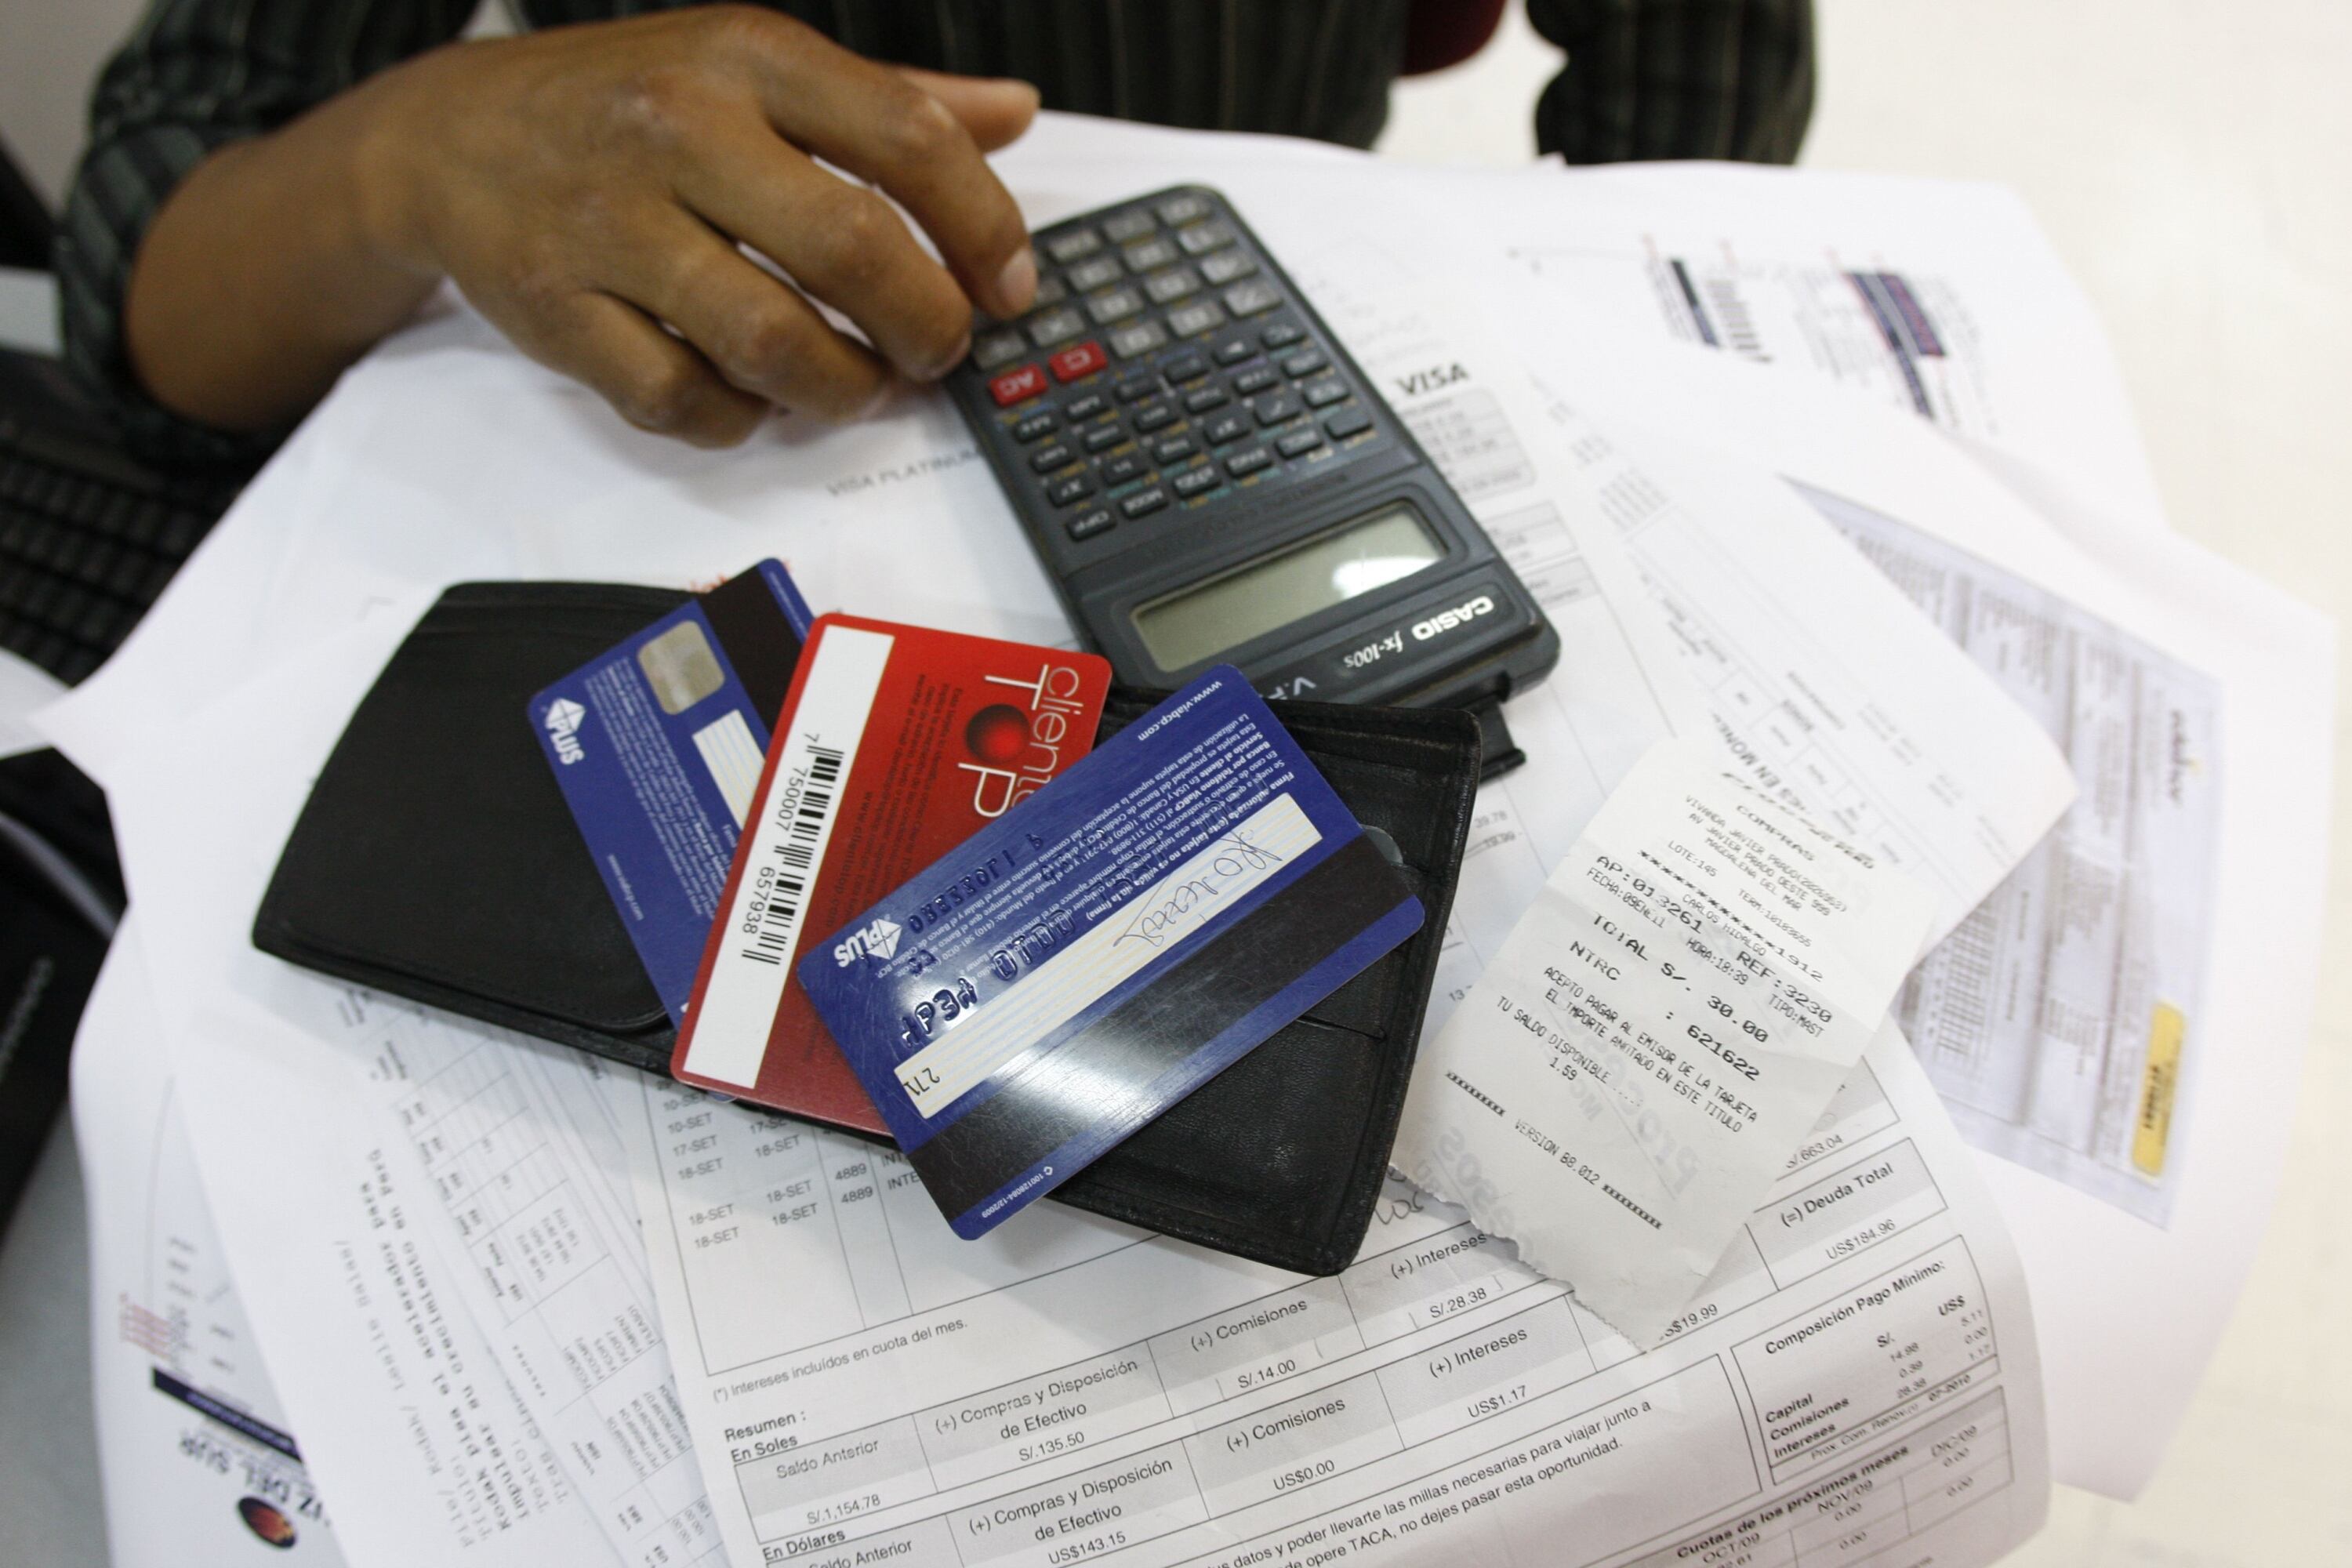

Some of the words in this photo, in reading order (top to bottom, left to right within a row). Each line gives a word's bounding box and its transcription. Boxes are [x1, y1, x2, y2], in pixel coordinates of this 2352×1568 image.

[998, 371, 1034, 397] AC
[1393, 363, 1470, 397] VISA
[1411, 596, 1494, 640] CASIO
[1344, 630, 1403, 667] fx-100s
[1137, 681, 1222, 741] www.viabcp.com
[1238, 722, 1256, 735] Esta
[550, 719, 584, 765] PLUS
[804, 732, 819, 743] 7
[1216, 732, 1240, 751] tarjeta
[1232, 731, 1263, 754] Servicio
[1245, 740, 1270, 759] Banca
[1171, 753, 1208, 785] propiedad
[1199, 757, 1225, 778] cliente
[1200, 767, 1234, 791] Teléfono
[1232, 755, 1247, 769] por
[1269, 771, 1294, 789] Firma
[775, 768, 808, 831] 750007
[1136, 789, 1160, 808] Banco
[1159, 780, 1171, 793] del
[1171, 782, 1190, 797] USA
[1174, 789, 1202, 811] ViaBCP
[1144, 812, 1167, 831] (511)
[1706, 827, 1741, 852] JAVIER
[1734, 804, 1817, 862] COMPRAS
[1667, 840, 1717, 877] LOTE:145
[1729, 829, 1765, 854] JAVIER
[742, 866, 775, 935] 657938
[1595, 855, 1710, 934] AP:013261
[1735, 949, 1832, 1023] REF:3230
[1682, 893, 1719, 924] CARLOS
[1721, 923, 1766, 956] HIDALGO
[834, 920, 887, 967] PLUS
[1685, 937, 1748, 985] HORA:18:39
[1768, 993, 1824, 1035] TIPO:MAST
[1569, 940, 1621, 981] NTRC
[1686, 1024, 1759, 1081] 621622
[1707, 995, 1769, 1043] 30.00
[1497, 995, 1512, 1012] TU
[1513, 1008, 1547, 1037] SALDO
[1548, 1033, 1609, 1083] DISPONIBLE
[1543, 966, 1584, 998] ACEPTO
[1584, 993, 1618, 1022] PAGAR
[1636, 1031, 1676, 1065] EMISOR
[1715, 1085, 1757, 1121] TARJETA
[902, 1066, 940, 1096] 271
[1548, 1056, 1577, 1081] 1.59
[1563, 997, 1606, 1038] IMPORTE
[1672, 1079, 1701, 1105] ESTE
[1704, 1100, 1742, 1133] TITULO
[668, 1111, 711, 1132] 10-SET
[1514, 1121, 1559, 1156] VERSION
[673, 1134, 717, 1152] 17-SET
[678, 1156, 722, 1178] 18-SET
[755, 1133, 800, 1156] 18-SET
[688, 1202, 734, 1224] 18-SET
[766, 1178, 811, 1203] 18-SET
[835, 1162, 867, 1179] 4889
[1802, 1184, 1853, 1214] Deuda
[1853, 1162, 1893, 1188] Total
[694, 1225, 739, 1247] 18-SET
[771, 1201, 817, 1224] 18-SET
[841, 1185, 873, 1203] 4889
[1415, 1229, 1488, 1266] Intereses
[1825, 1218, 1895, 1259] US$184.96
[1215, 1300, 1307, 1339] Comisiones
[1236, 1359, 1296, 1388] S/.14.00
[1428, 1287, 1487, 1319] S/.28.38
[1765, 1305, 1855, 1354] Composición
[1855, 1287, 1891, 1311] Pago
[731, 1371, 789, 1395] Intereses
[791, 1353, 850, 1377] incluídos
[851, 1348, 869, 1361] en
[871, 1335, 908, 1355] cuota
[910, 1326, 932, 1342] del
[934, 1319, 967, 1335] mes.
[960, 1394, 1032, 1423] Compras
[1047, 1359, 1138, 1397] Disposición
[1251, 1399, 1345, 1440] Comisiones
[1454, 1328, 1527, 1366] Intereses
[1000, 1424, 1020, 1439] de
[1023, 1403, 1087, 1432] Efectivo
[1765, 1393, 1813, 1423] Capital
[1769, 1398, 1849, 1440] Comisiones
[724, 1414, 796, 1441] Resumen
[1018, 1430, 1085, 1461] S/.135.50
[1272, 1457, 1337, 1492] US$0.00
[1465, 1383, 1529, 1420] US$1.17
[1451, 1453, 1527, 1490] necesarias
[1529, 1439, 1563, 1461] para
[1563, 1421, 1601, 1444] viajar
[1603, 1406, 1639, 1431] junto
[1642, 1400, 1651, 1412] a
[1773, 1424, 1835, 1457] Intereses
[730, 1447, 751, 1463] En
[753, 1436, 797, 1456] Soles
[775, 1458, 818, 1479] Saldo
[822, 1439, 878, 1465] Anterior
[993, 1494, 1065, 1525] Compras
[1080, 1460, 1173, 1497] Disposición
[1461, 1487, 1500, 1513] pasar
[1504, 1474, 1535, 1494] esta
[1537, 1436, 1622, 1480] oportunidad.
[806, 1493, 880, 1525] S/.1,154.78
[1676, 1530, 1733, 1559] Cuotas
[1737, 1519, 1755, 1534] de
[1759, 1507, 1784, 1523] los
[1786, 1472, 1857, 1512] próximos
[1860, 1446, 1908, 1475] meses
[1034, 1525, 1054, 1541] de
[1057, 1504, 1122, 1534] Efectivo
[1232, 1548, 1272, 1568] datos
[1286, 1528, 1327, 1553] poder
[1329, 1509, 1381, 1535] llevarte
[1382, 1500, 1406, 1515] las
[1407, 1483, 1450, 1506] millas
[1305, 1545, 1346, 1567] opere
[1348, 1527, 1396, 1551] TACA,
[1398, 1519, 1417, 1534] no
[1420, 1504, 1459, 1526] dejes
[761, 1546, 783, 1561] En
[785, 1530, 846, 1555] Dólares
[1047, 1530, 1126, 1564] US$143.15
